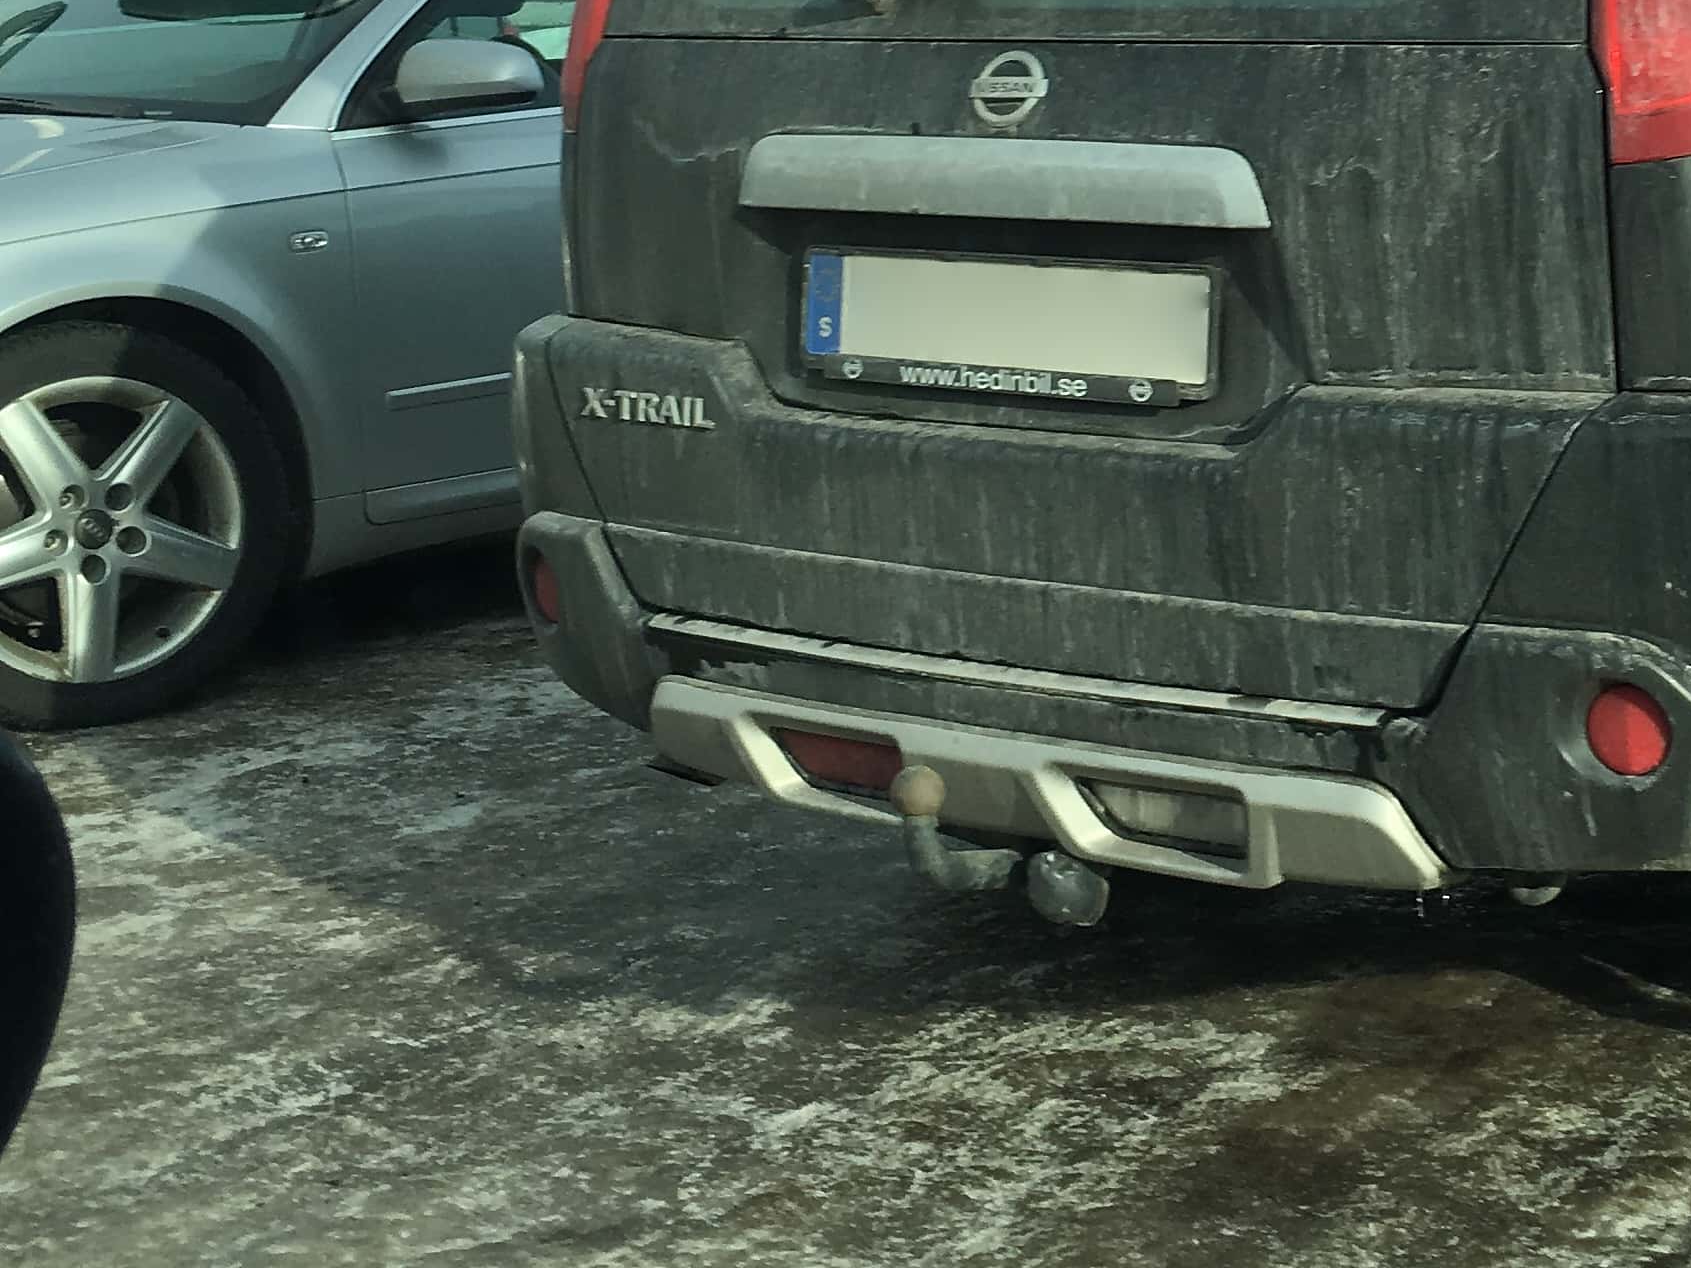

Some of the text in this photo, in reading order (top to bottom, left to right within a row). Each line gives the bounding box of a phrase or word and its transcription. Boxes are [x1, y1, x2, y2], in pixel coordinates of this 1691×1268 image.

[818, 316, 833, 338] S
[899, 362, 1089, 399] www.hedinbil.se
[579, 387, 717, 429] X-TRAIL
